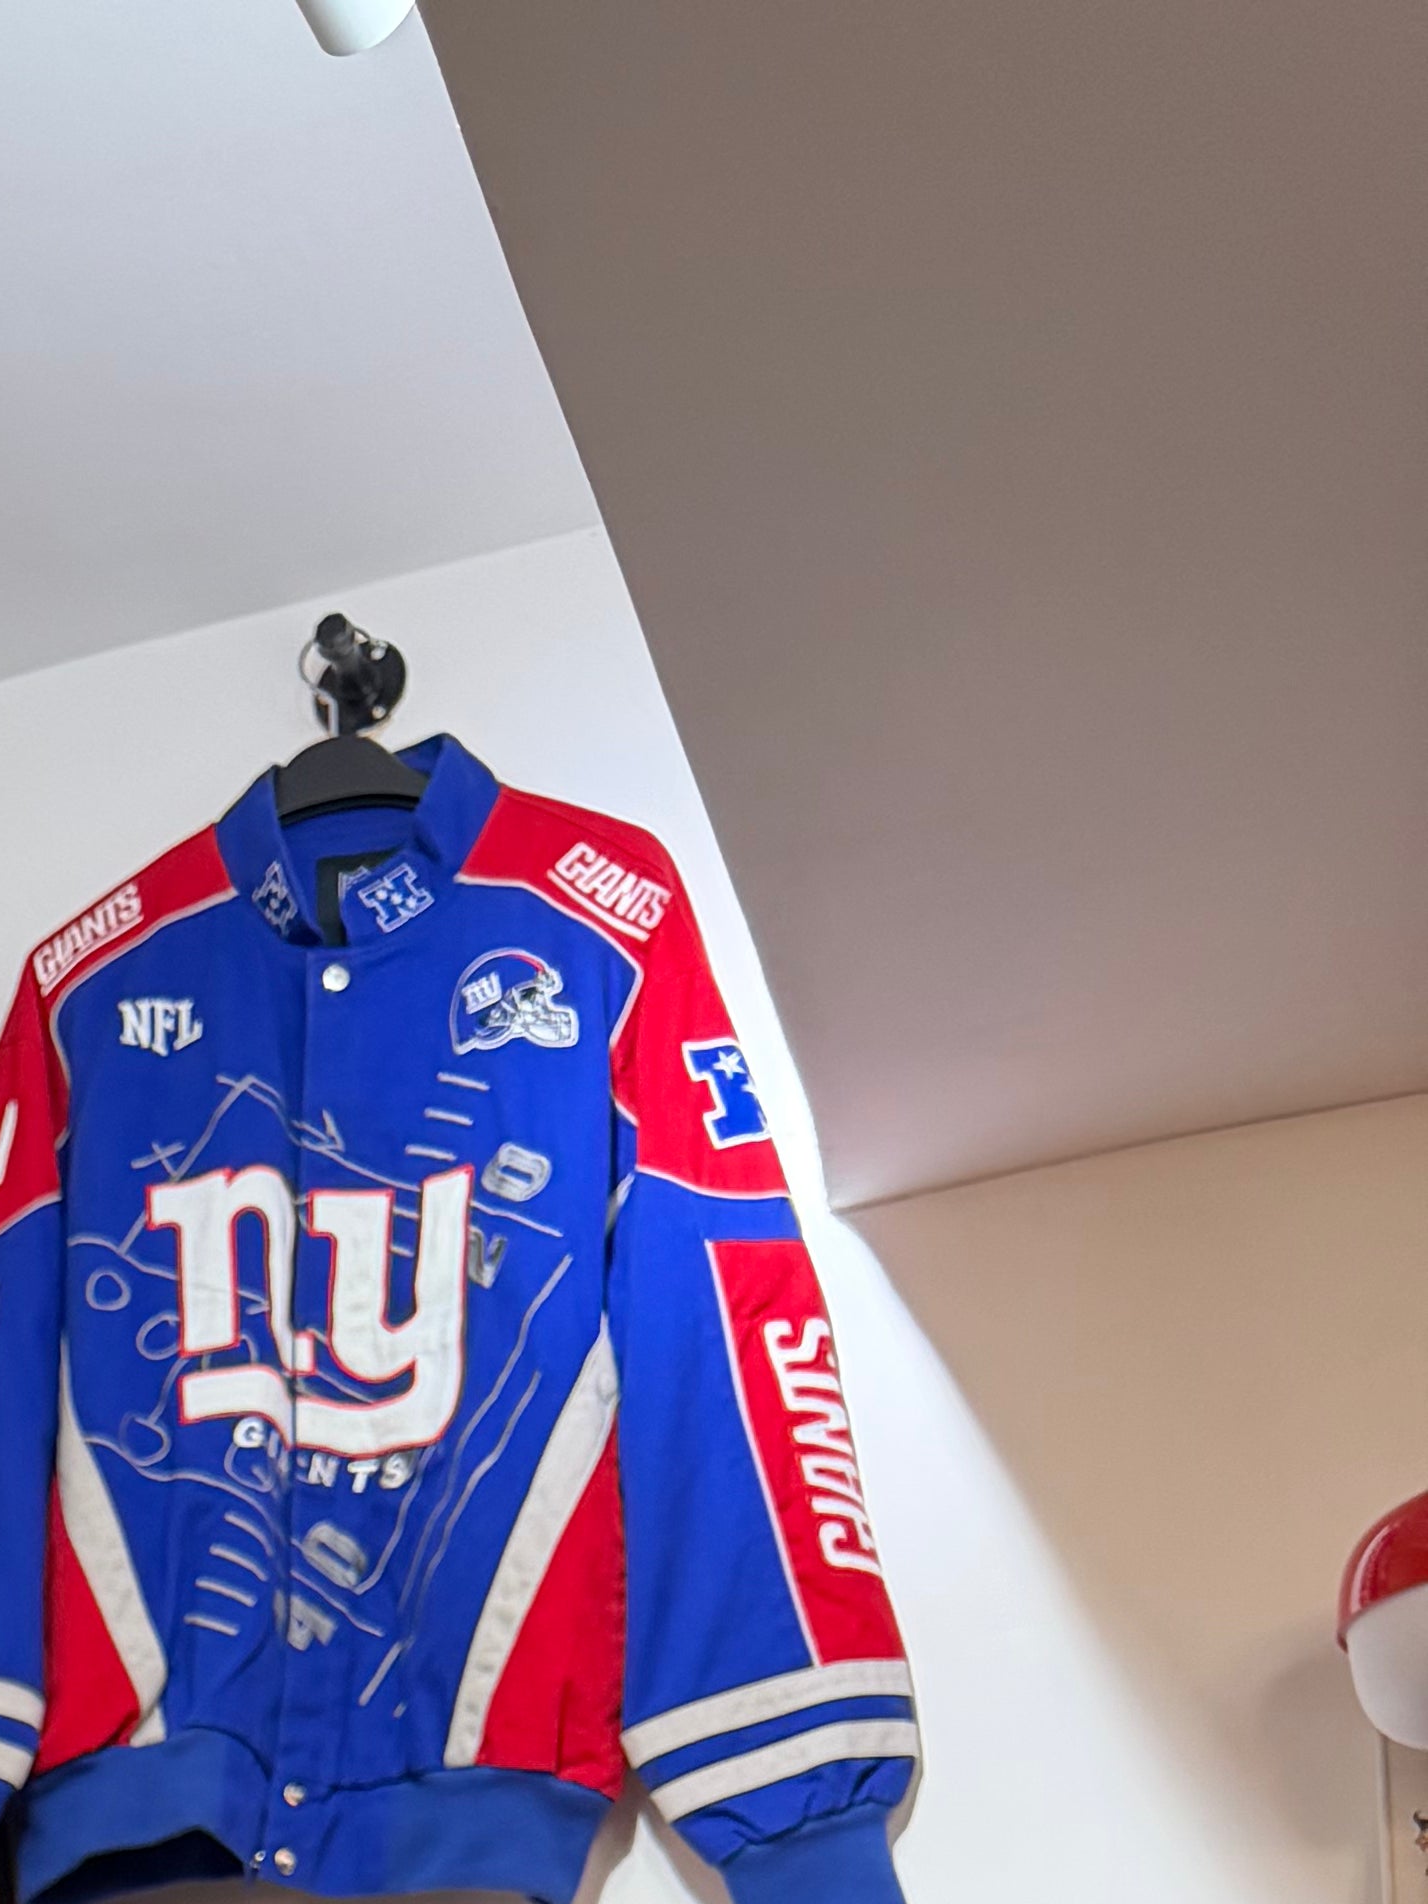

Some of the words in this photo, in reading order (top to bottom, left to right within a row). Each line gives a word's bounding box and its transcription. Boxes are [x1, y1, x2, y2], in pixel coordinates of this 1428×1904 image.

[554, 841, 673, 931] GIANTS
[32, 881, 144, 983] GIANTS
[117, 997, 204, 1057] NFL
[232, 1416, 414, 1494] GINTS
[763, 1317, 883, 1577] GIANTS
